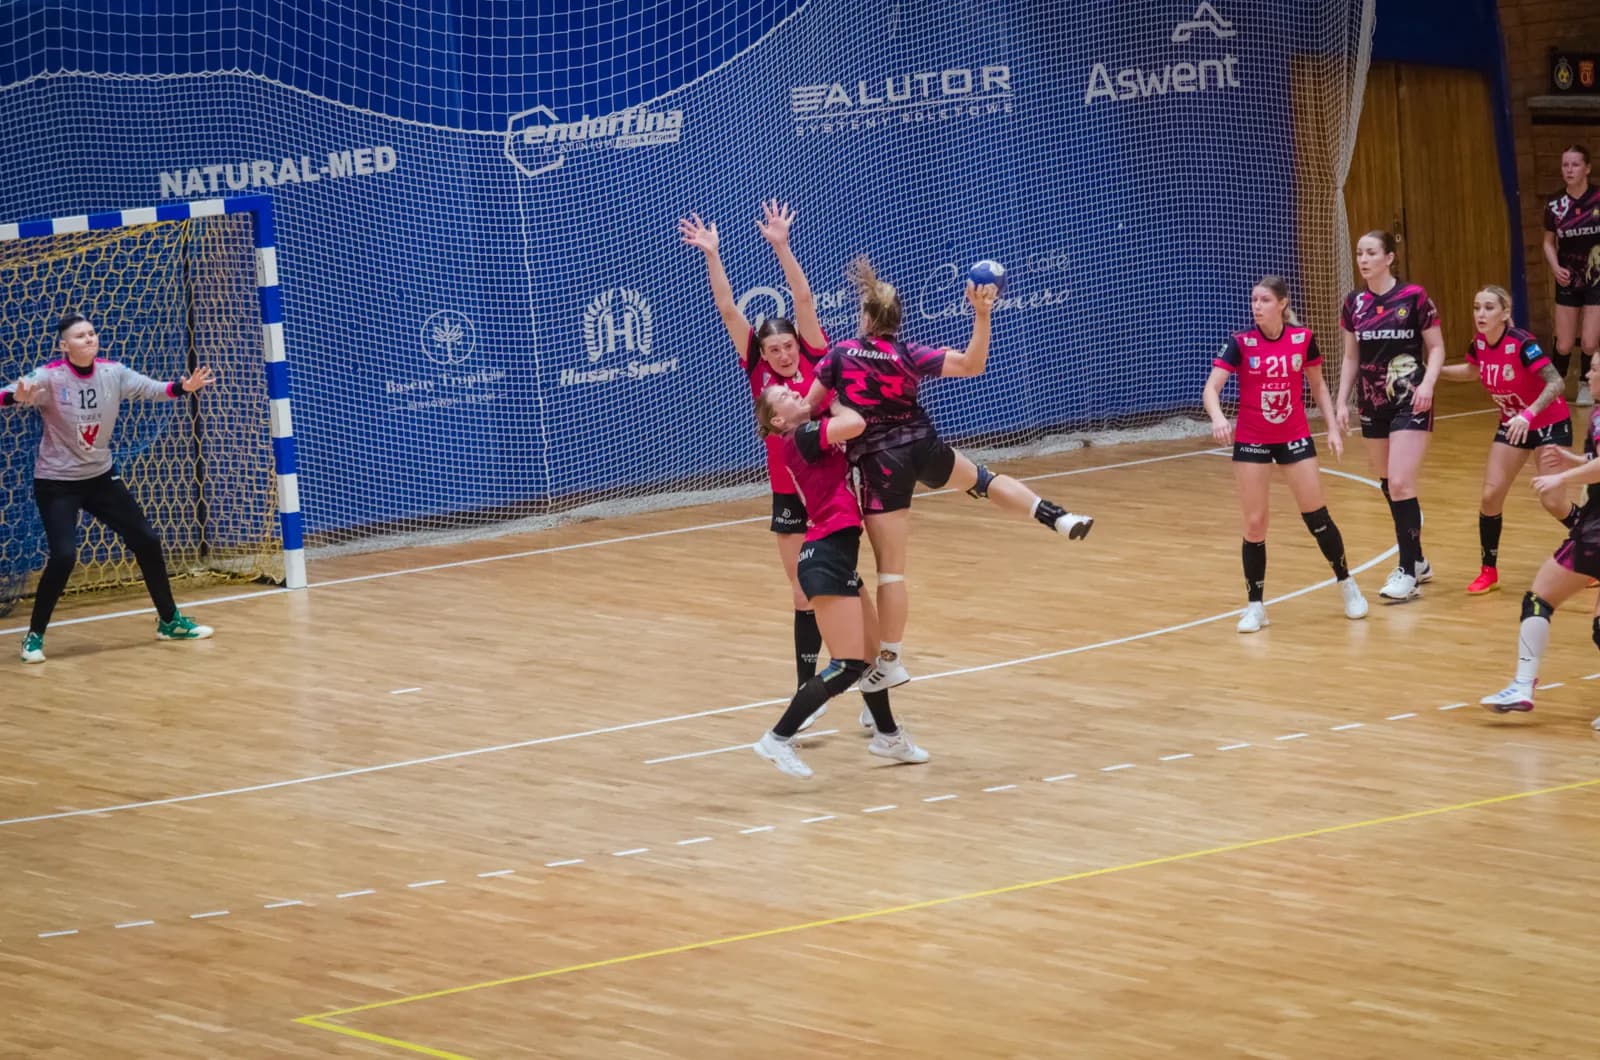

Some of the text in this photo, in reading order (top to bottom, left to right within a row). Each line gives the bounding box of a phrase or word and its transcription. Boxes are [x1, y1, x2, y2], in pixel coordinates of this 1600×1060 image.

[823, 66, 1012, 109] ALUTOR
[1085, 54, 1240, 106] Aswent
[523, 108, 683, 145] endorfina
[159, 146, 397, 199] NATURAL-MED
[1362, 329, 1414, 341] SUZUKI
[560, 358, 678, 386] Husar-Sport
[1265, 355, 1289, 378] 21
[1486, 364, 1500, 387] 17
[79, 388, 97, 410] 12
